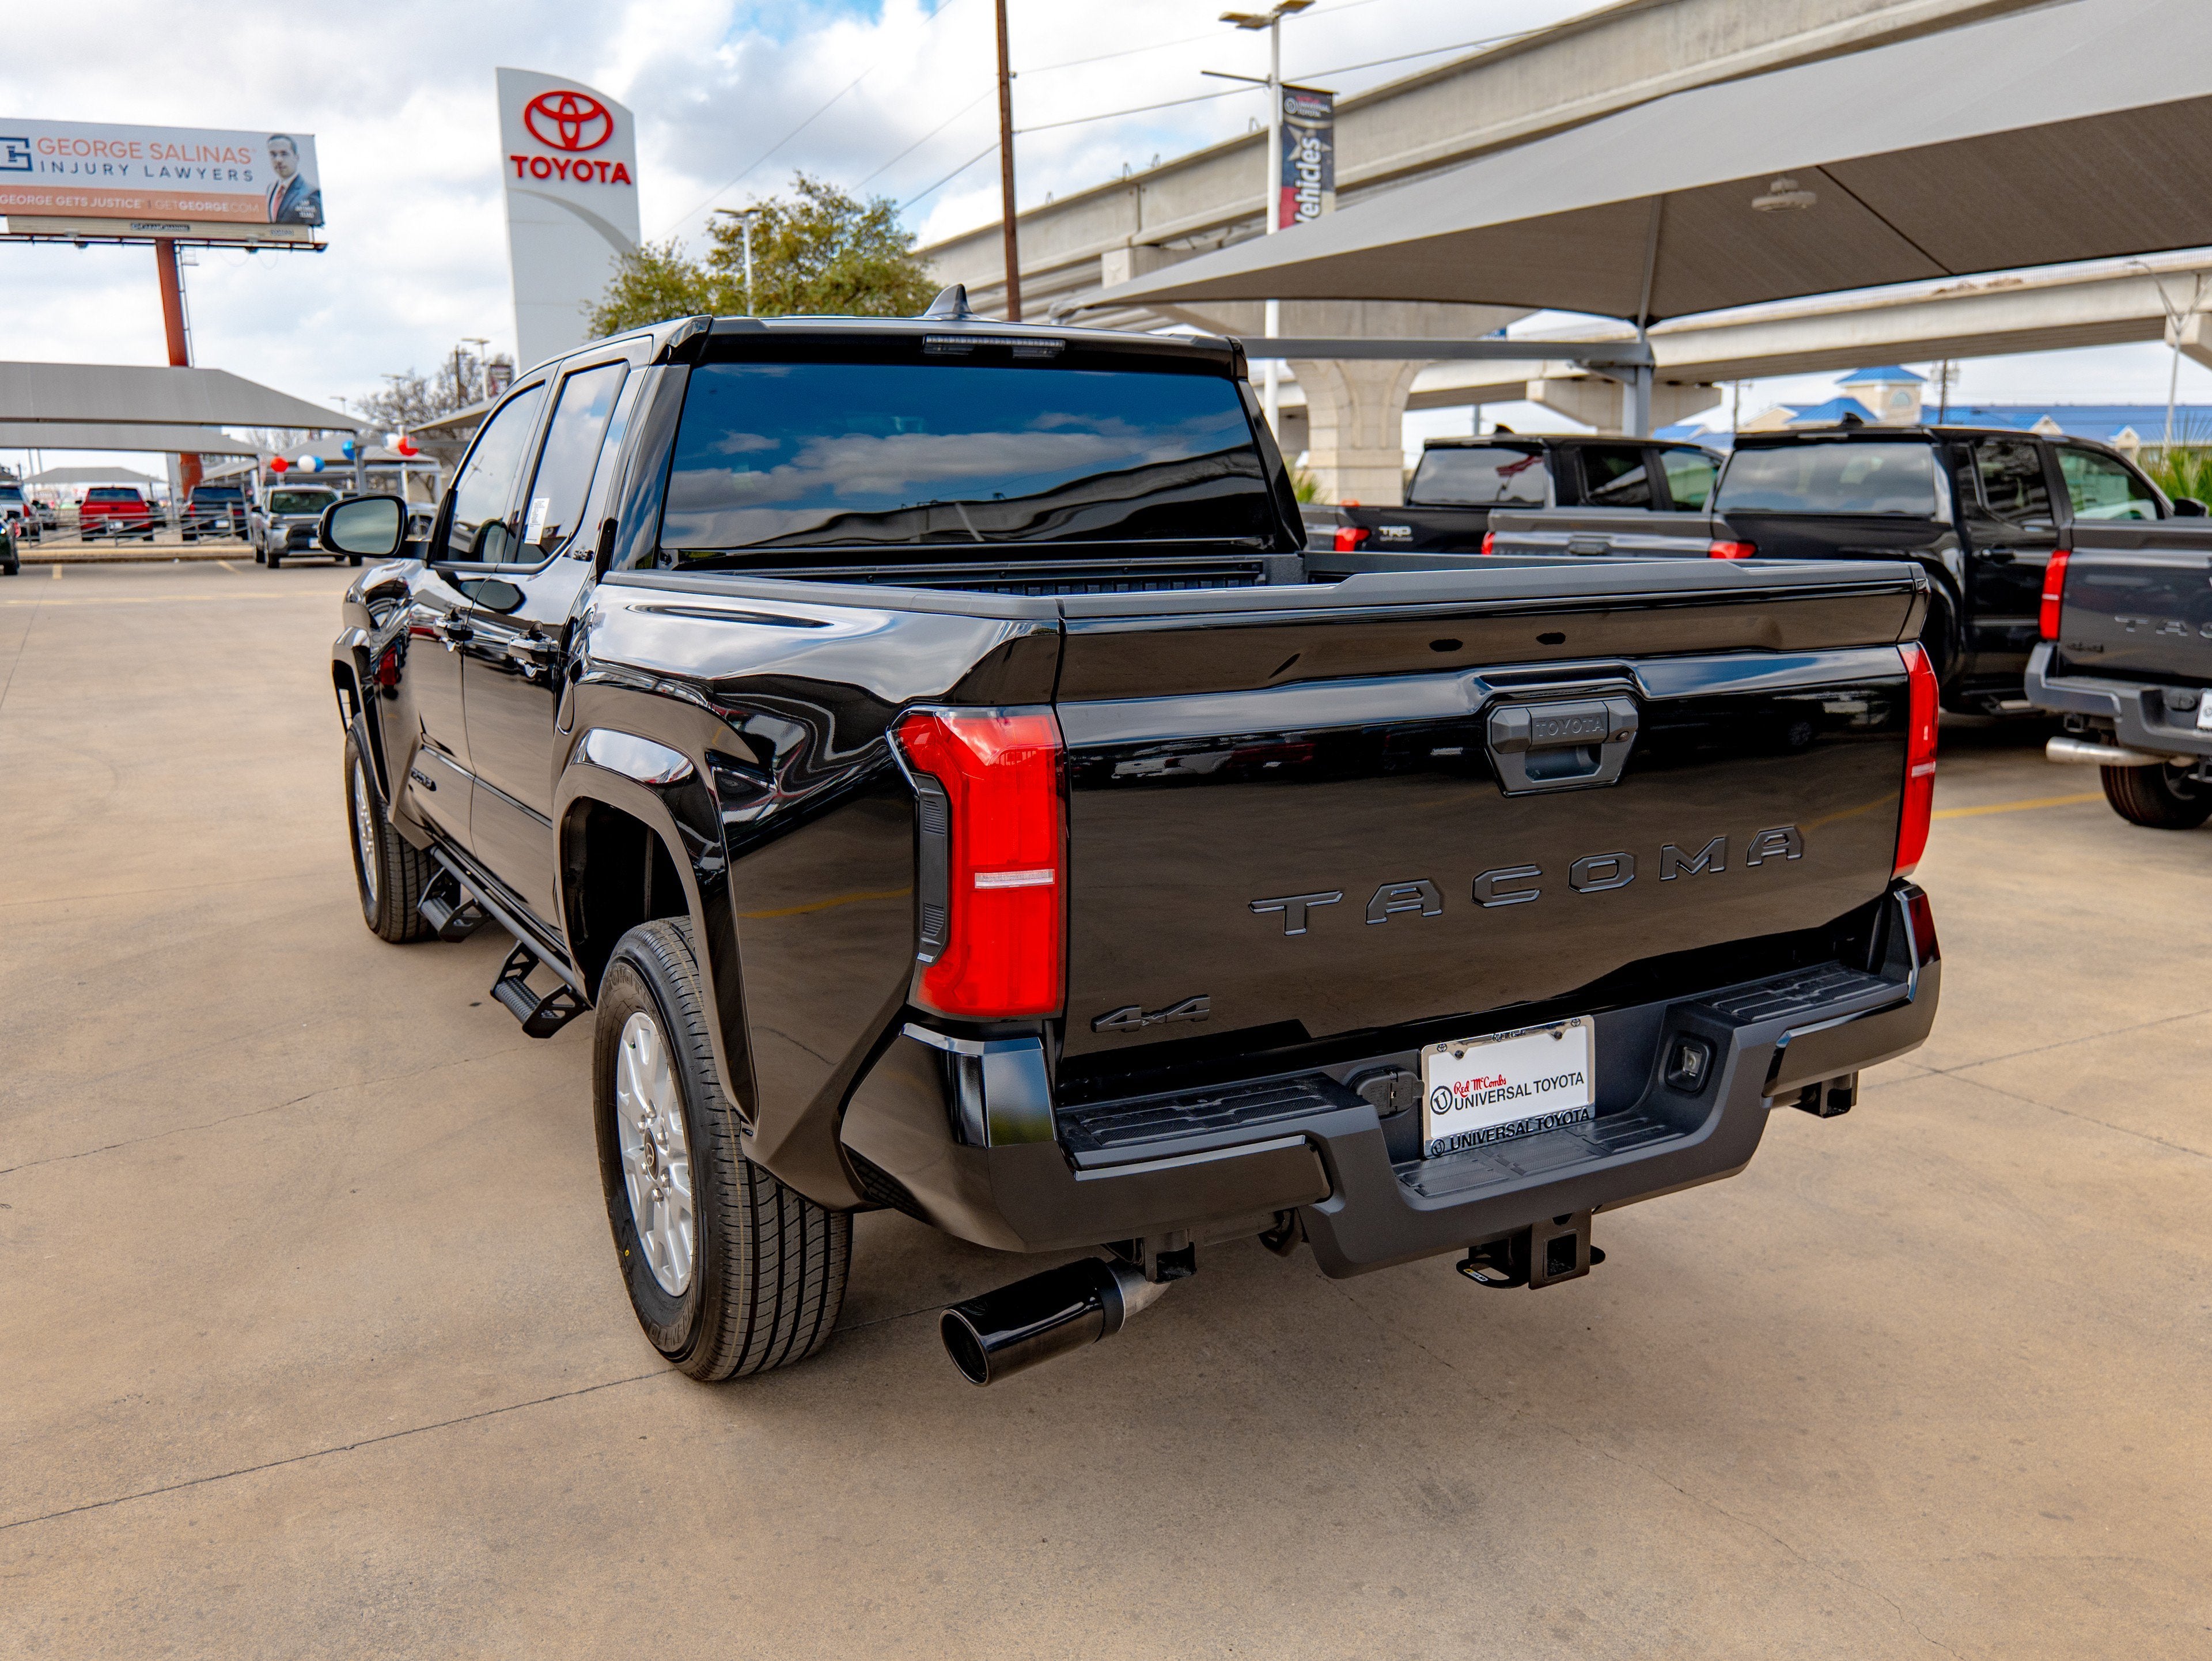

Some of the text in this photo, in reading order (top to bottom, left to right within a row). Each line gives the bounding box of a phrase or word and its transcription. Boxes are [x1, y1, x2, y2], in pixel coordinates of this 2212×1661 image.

[37, 137, 252, 164] GEORGE SALINAS
[40, 160, 253, 182] INJURY LAWYERS
[510, 155, 631, 184] TOYOTA
[0, 194, 52, 206] GEORGE
[56, 196, 88, 207] GETS
[90, 197, 142, 209] JUSTICE
[1378, 525, 1412, 536] TRD
[1535, 716, 1605, 737] TOYOTA
[1248, 825, 1804, 936] TACOMA
[1453, 1074, 1507, 1098] Red McCombs
[1454, 1072, 1585, 1111] UNIVERSAL TOYOTA
[1450, 1107, 1590, 1151] UNIVERSAL TOYOTA
